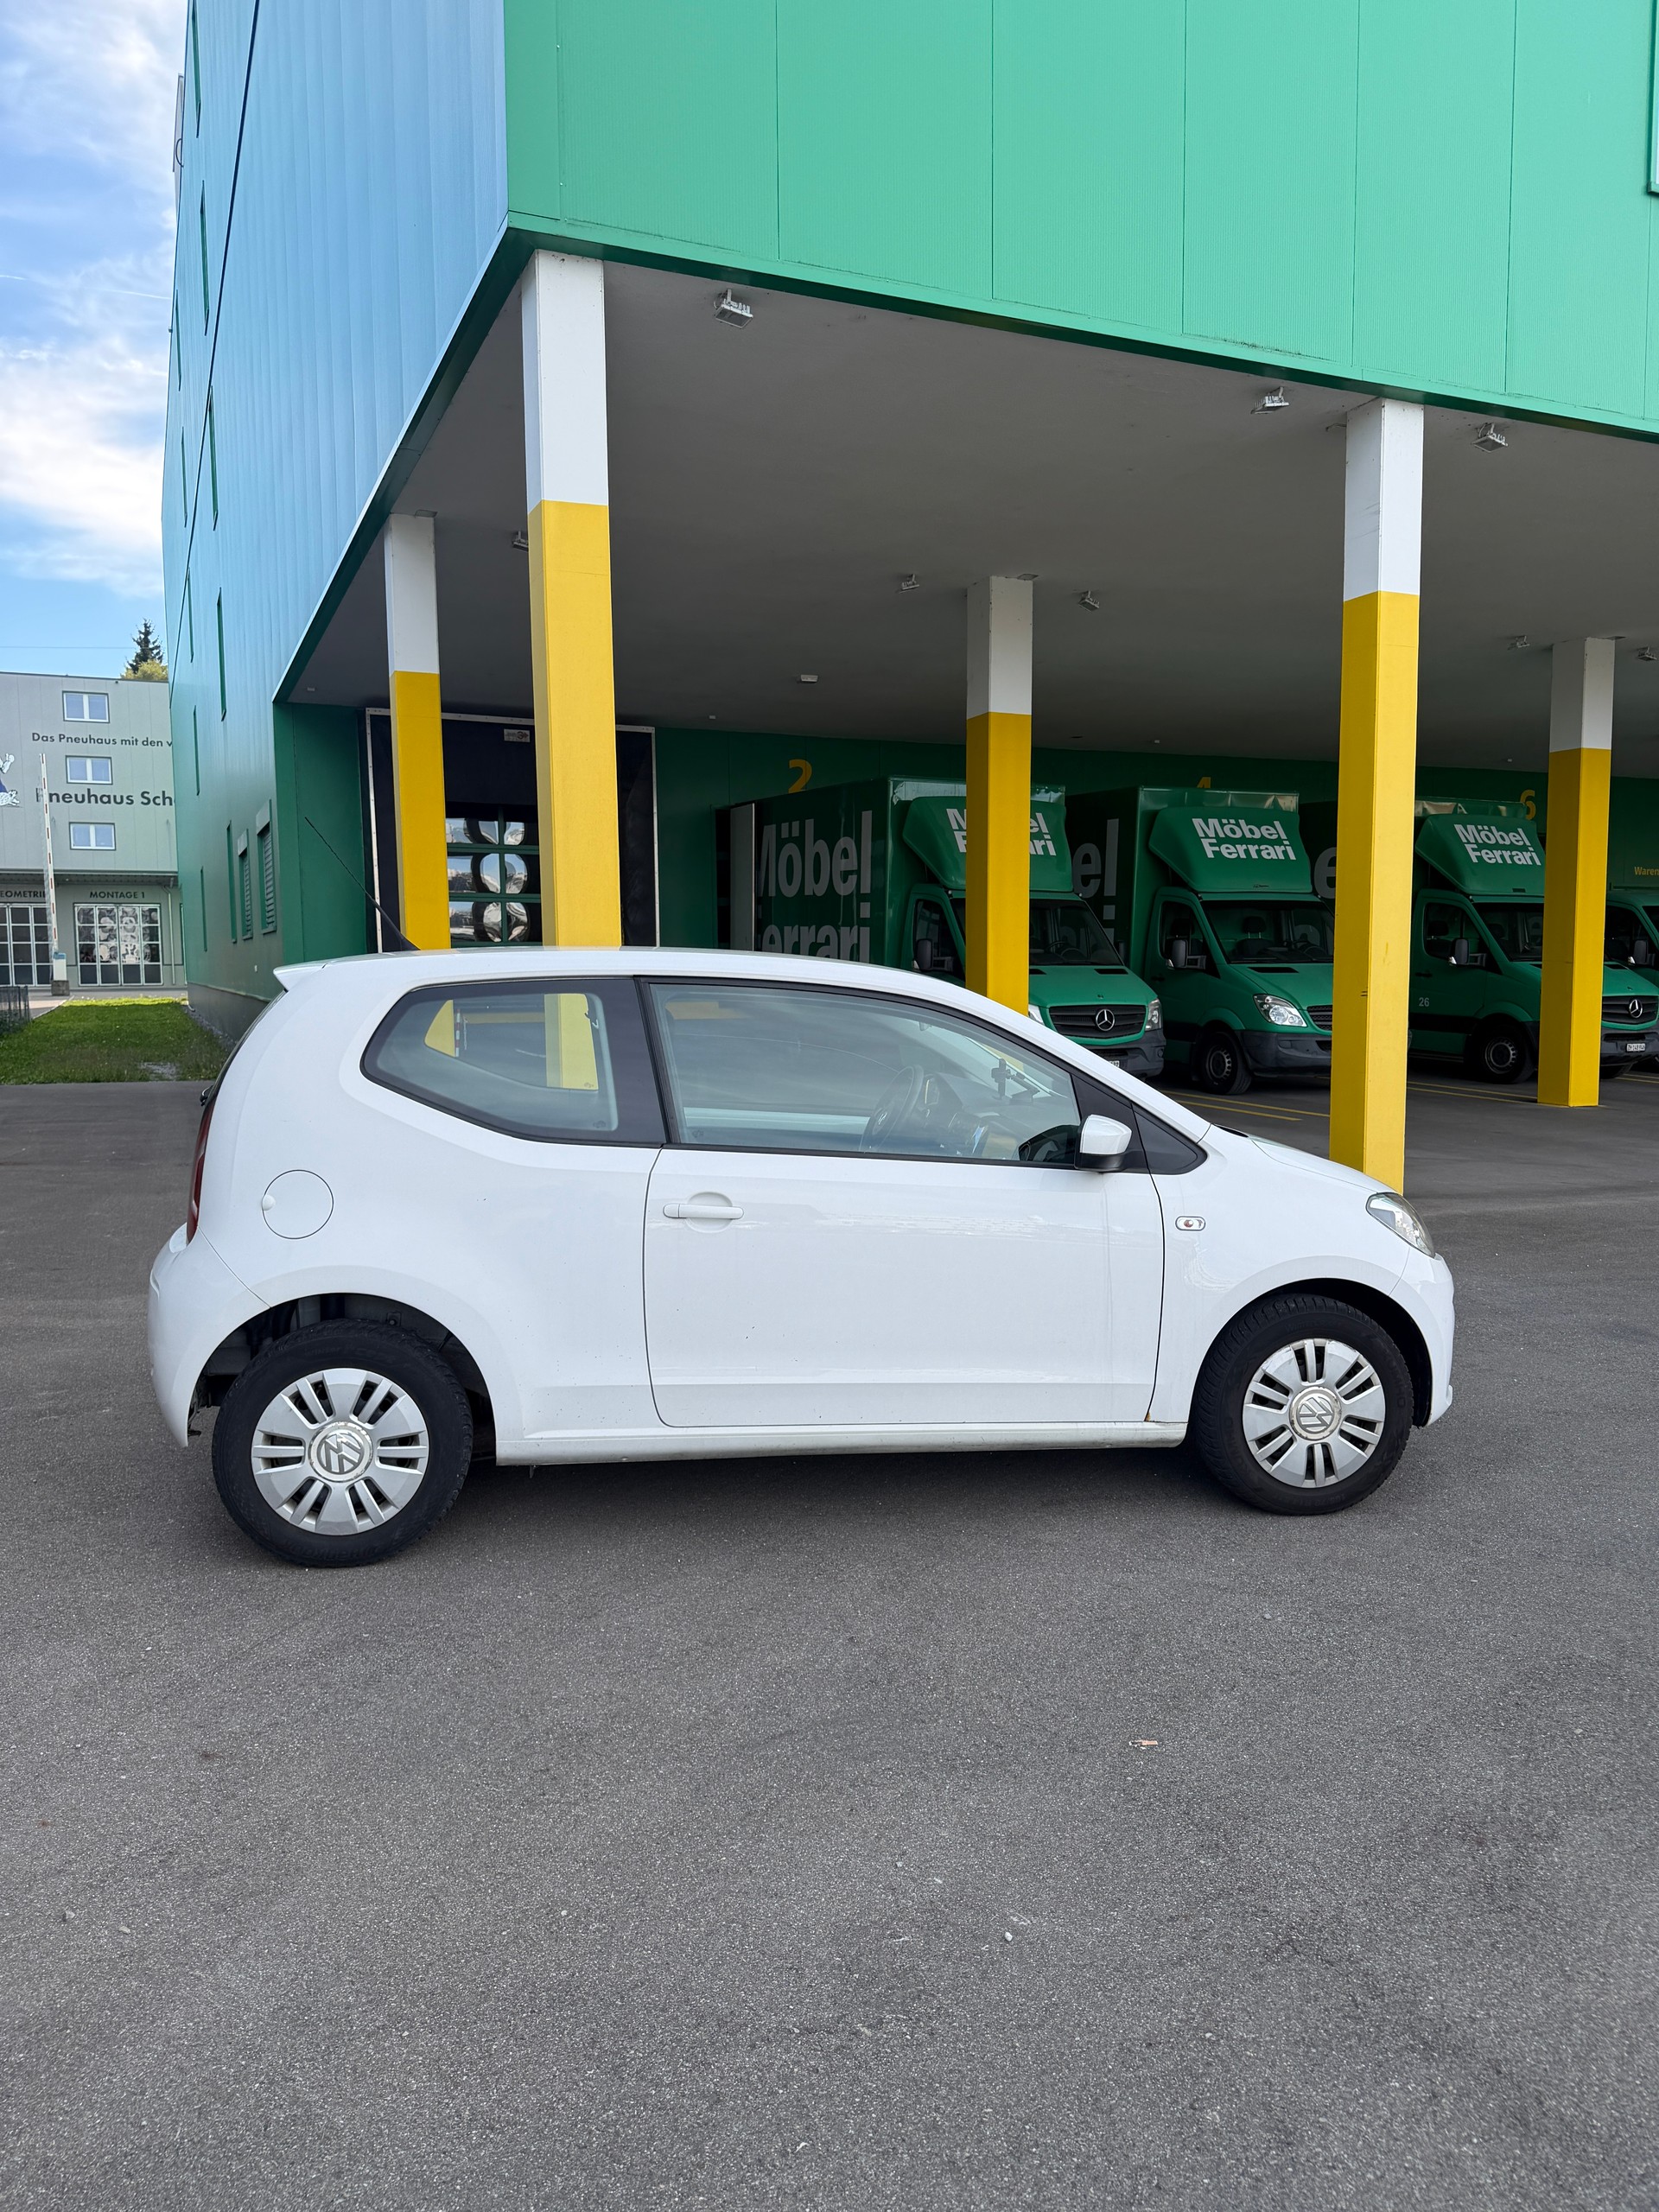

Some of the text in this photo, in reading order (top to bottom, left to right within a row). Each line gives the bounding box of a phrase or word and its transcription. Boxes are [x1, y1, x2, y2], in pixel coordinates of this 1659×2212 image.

[32, 732, 55, 743] Das
[59, 734, 118, 746] Pneuhaus
[121, 736, 138, 747] mit
[142, 737, 163, 747] den
[788, 759, 812, 794] 2
[140, 790, 175, 806] Sch
[1519, 789, 1536, 821] 6
[1192, 817, 1288, 841] Möbel
[1453, 823, 1532, 847] Möbel
[1200, 837, 1297, 861] Ferrari
[1464, 843, 1541, 866] Ferrari
[1418, 997, 1430, 1007] 26
